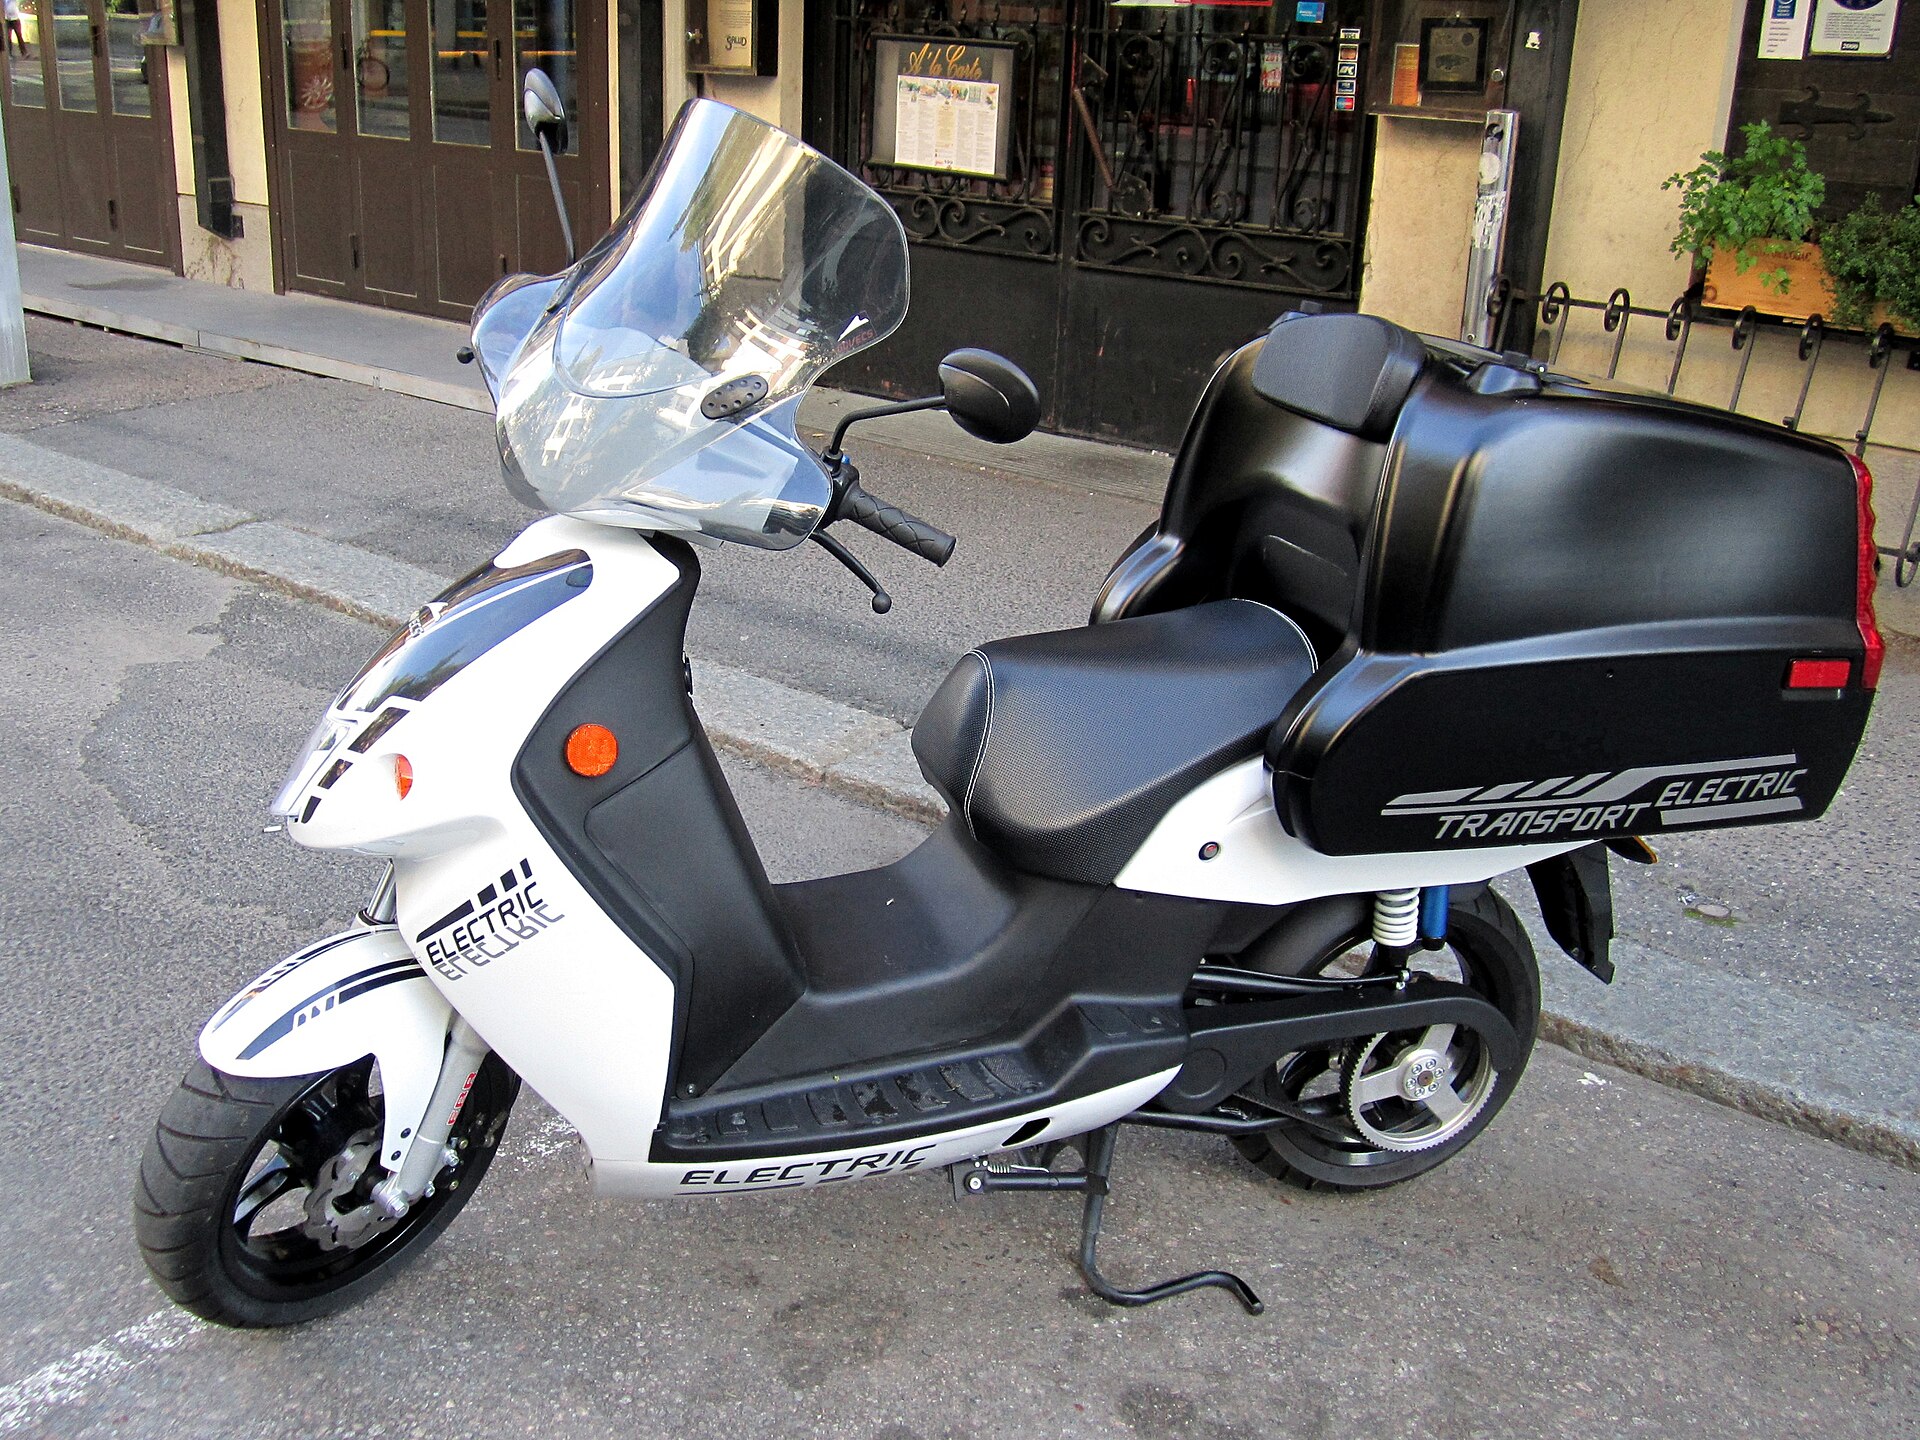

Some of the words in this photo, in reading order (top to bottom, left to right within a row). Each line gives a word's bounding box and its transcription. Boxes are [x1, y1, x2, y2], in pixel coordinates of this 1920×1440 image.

[1434, 802, 1653, 840] TRANSPORT
[1654, 769, 1808, 807] ELECTRIC
[426, 881, 543, 966] ELECTRIC
[680, 1144, 937, 1184] ELECTRIC
